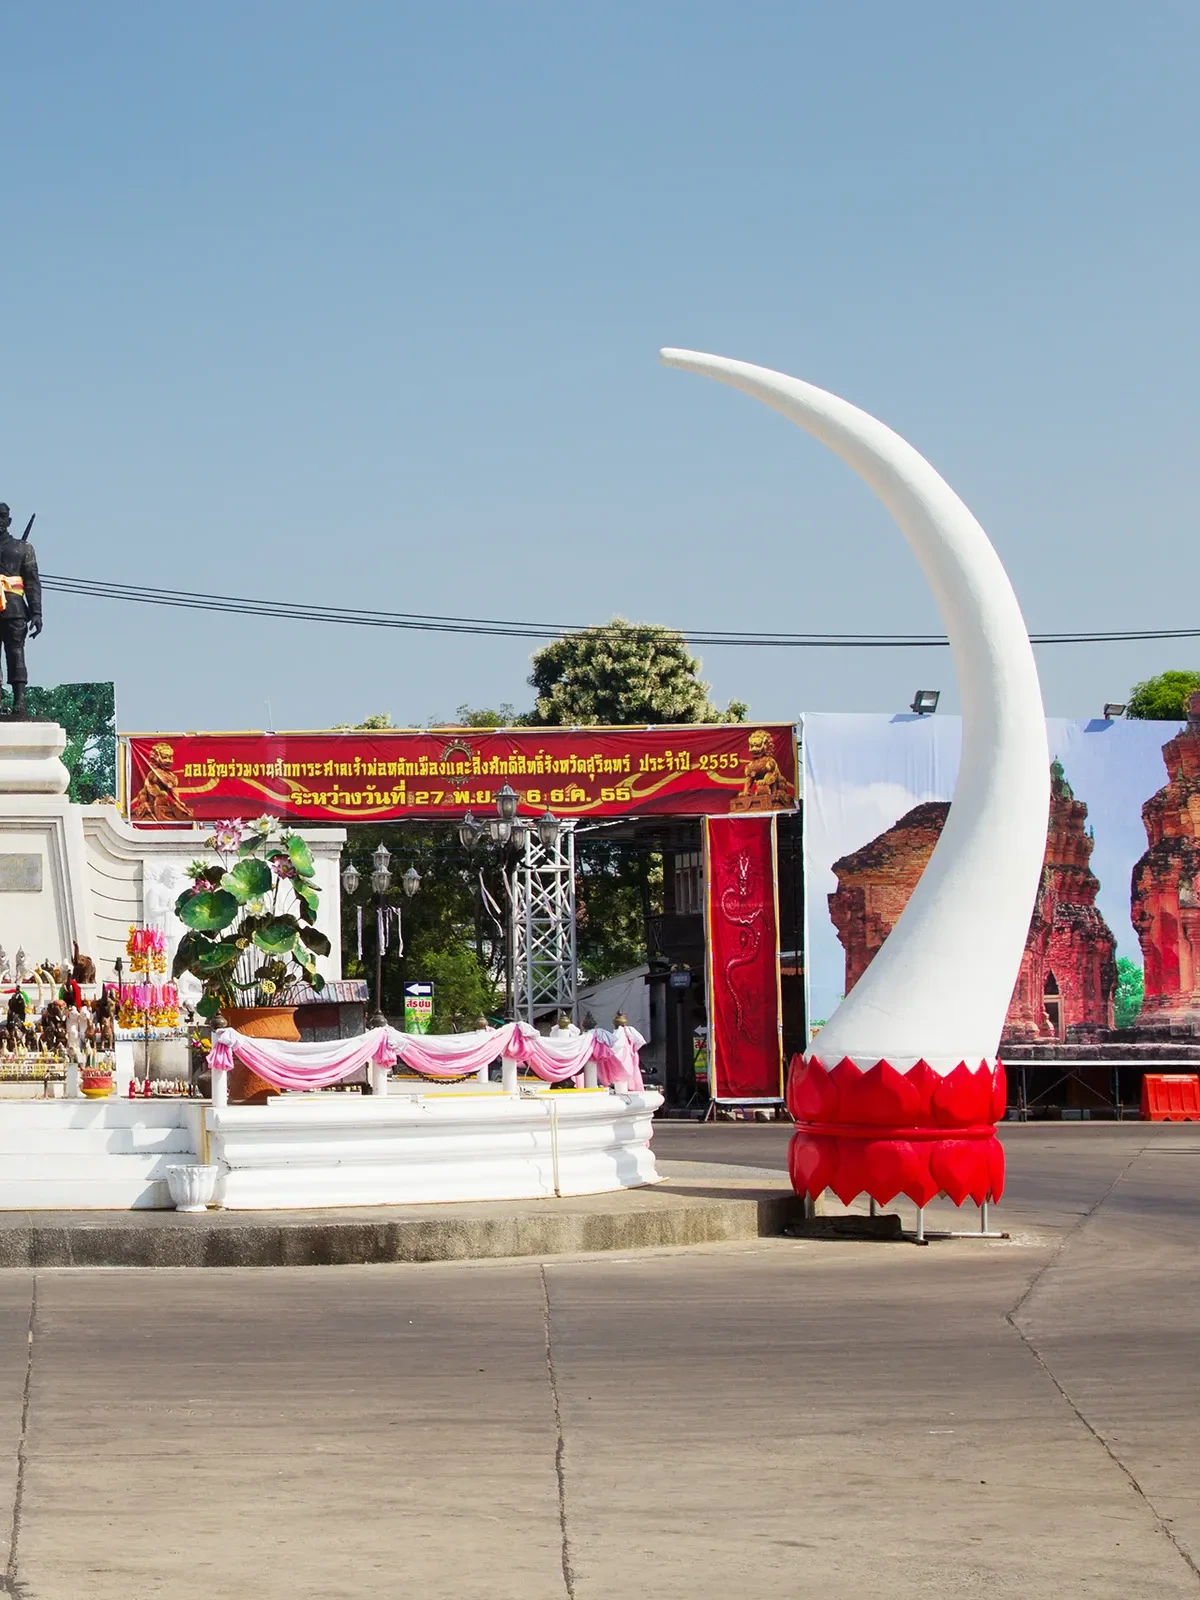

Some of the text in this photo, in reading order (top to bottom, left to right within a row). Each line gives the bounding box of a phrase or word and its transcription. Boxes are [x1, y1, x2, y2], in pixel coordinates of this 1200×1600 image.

[639, 750, 690, 772] ประจำปี
[700, 753, 739, 770] 2555
[290, 779, 632, 806] ระหว่างวันที่ 27 พ.ย. 6 ธ.ค. 55
